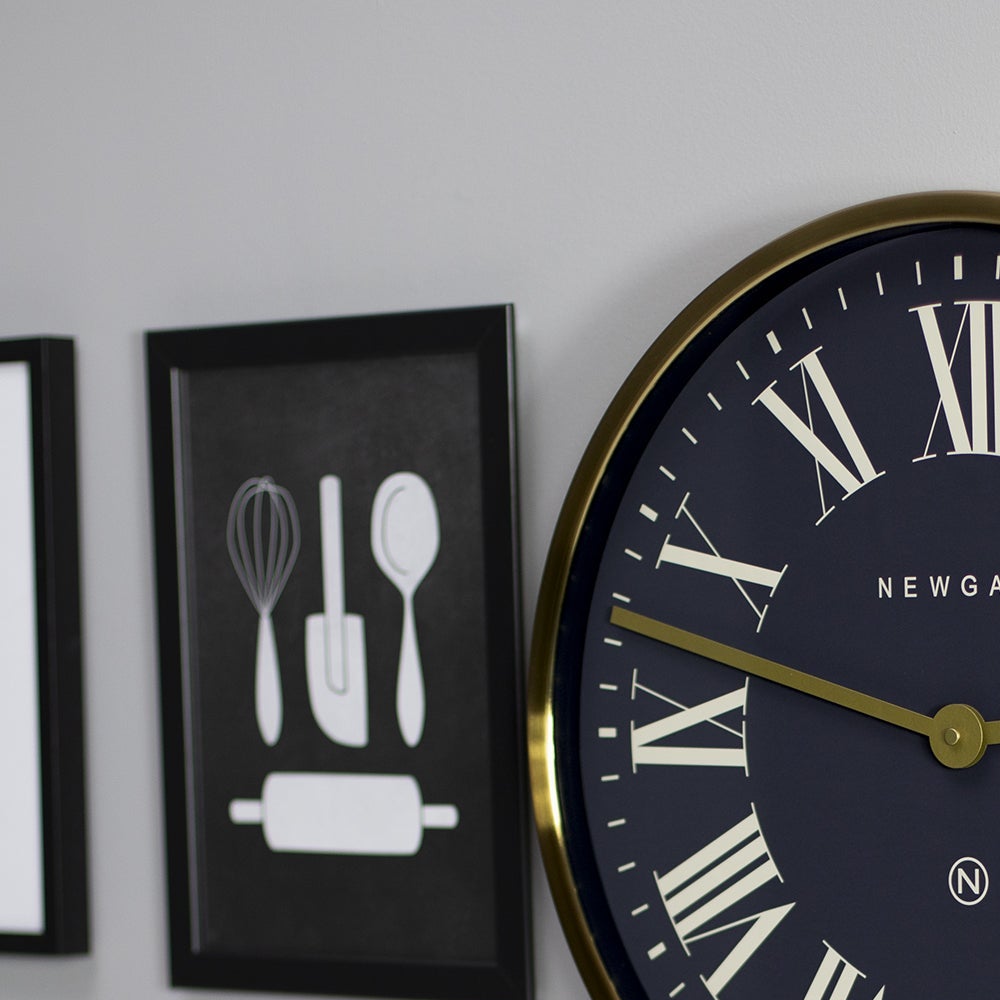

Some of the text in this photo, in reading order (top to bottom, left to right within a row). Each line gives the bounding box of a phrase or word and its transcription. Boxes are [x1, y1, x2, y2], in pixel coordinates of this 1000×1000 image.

[752, 346, 886, 526] XI
[655, 493, 789, 632] X
[630, 668, 750, 777] IX
